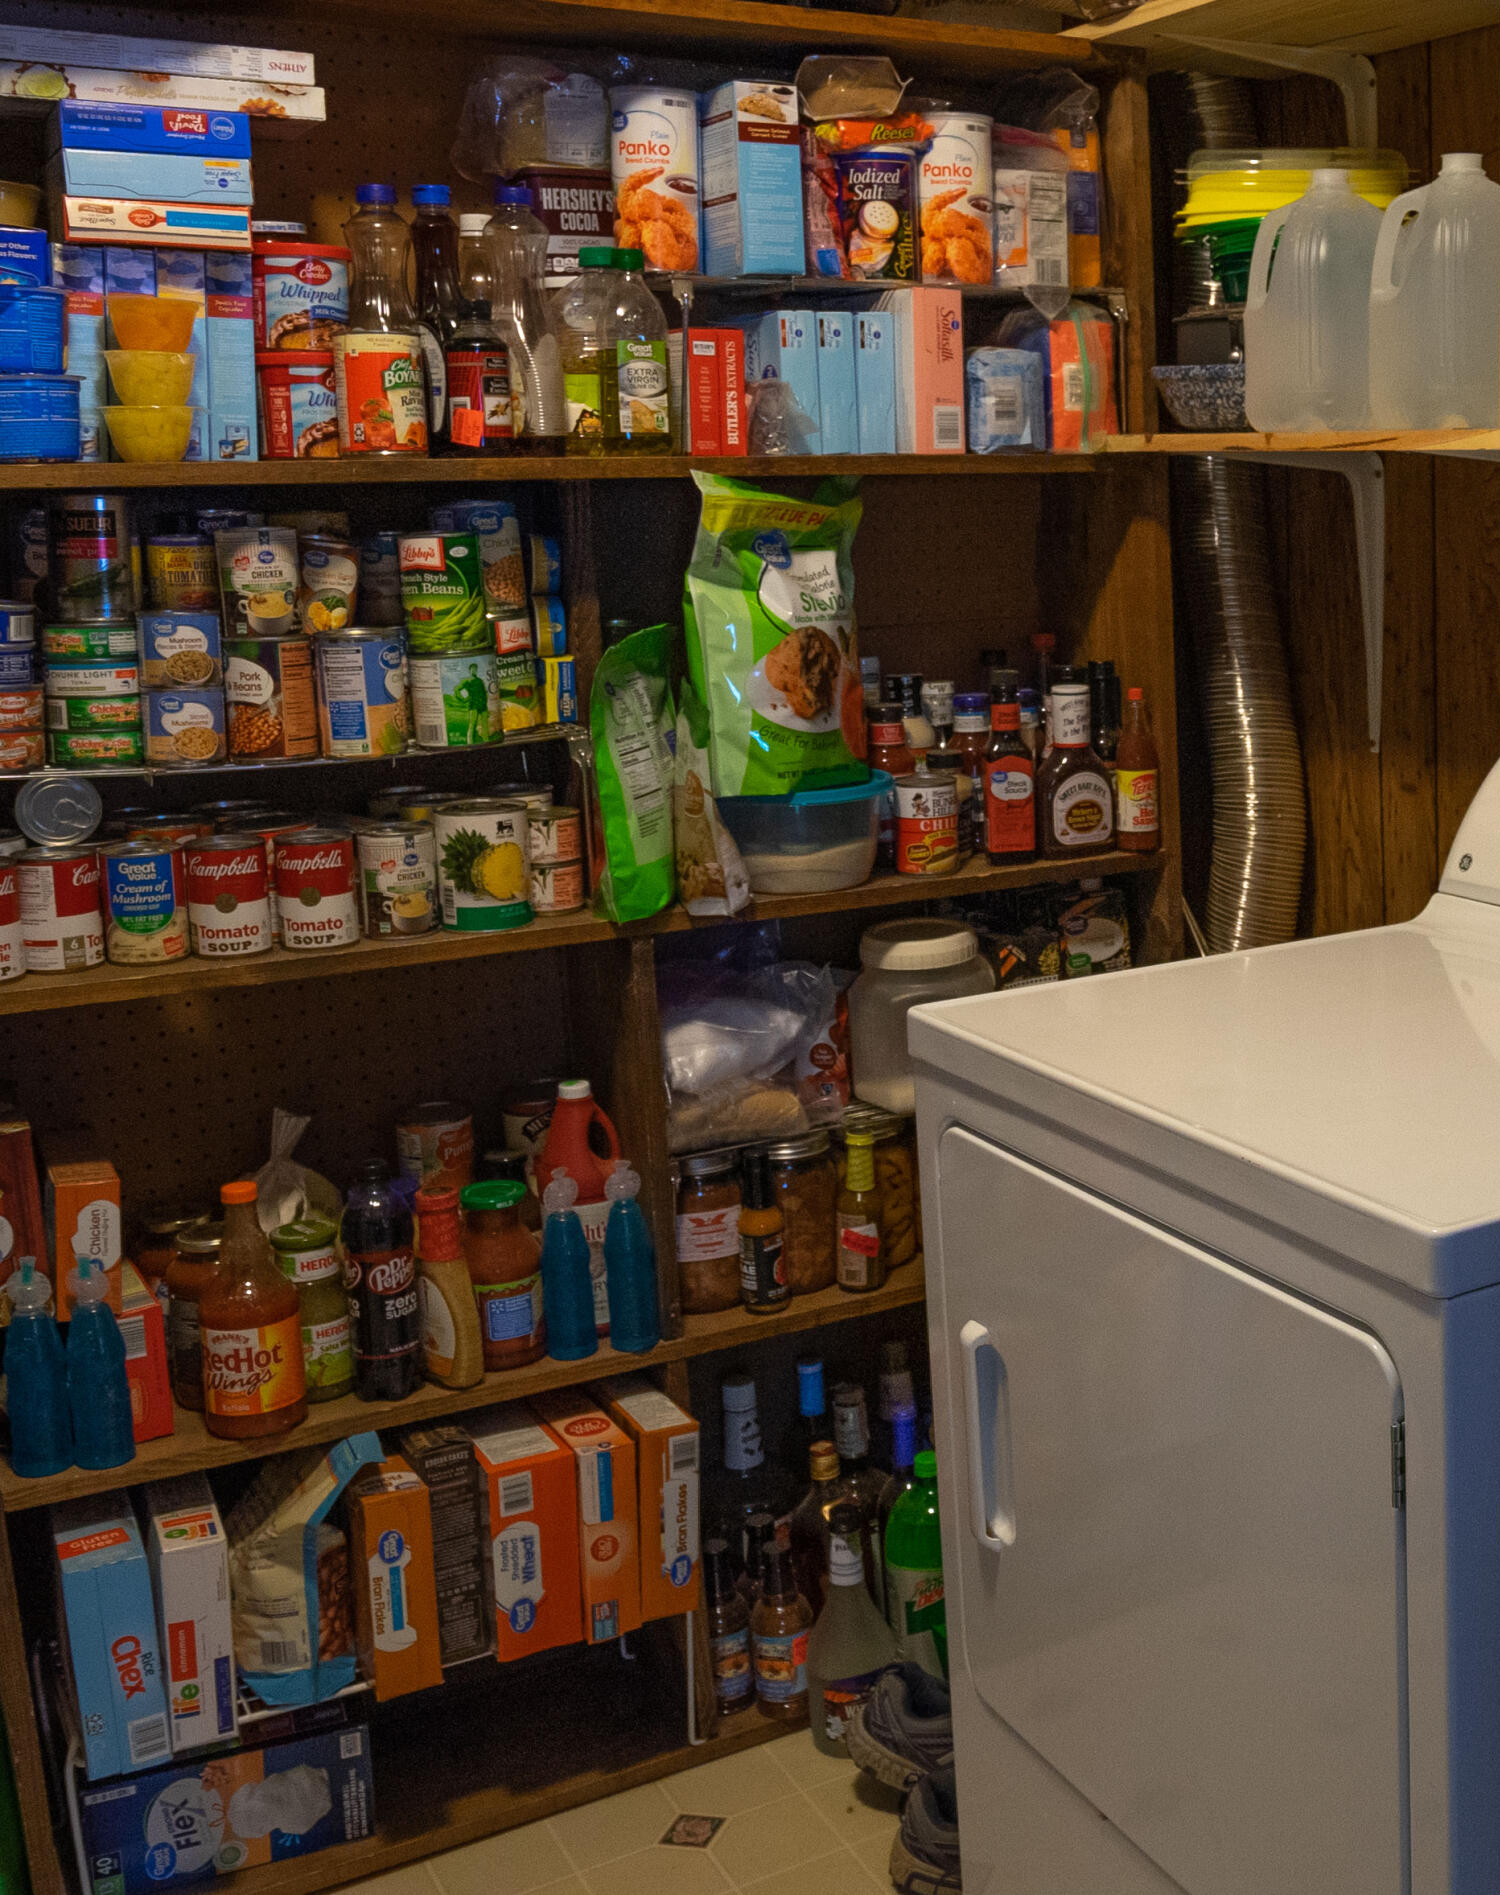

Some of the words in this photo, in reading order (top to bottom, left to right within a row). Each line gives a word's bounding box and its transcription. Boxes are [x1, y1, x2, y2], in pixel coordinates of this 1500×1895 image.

[871, 124, 915, 141] Reese's
[618, 140, 671, 157] Panko
[848, 168, 901, 185] Iodized
[922, 163, 973, 179] Panko
[542, 187, 614, 212] HERSHEY'S
[853, 184, 884, 201] Salt
[559, 212, 600, 231] COCOA
[280, 280, 341, 304] Whipped
[626, 367, 659, 378] EXTRA
[726, 340, 737, 389] EXTRACTS
[626, 376, 660, 386] VIRGIN
[726, 390, 740, 446] BUTLER'S
[401, 546, 436, 562] Libby's
[251, 569, 284, 580] CHICKEN
[422, 573, 449, 583] Style
[422, 582, 465, 596] Beans
[800, 591, 847, 613] Stevia
[495, 654, 525, 667] Cream
[83, 670, 113, 679] LIGHT
[239, 671, 262, 682] Pork
[232, 681, 262, 692] Beans
[117, 861, 156, 875] Great
[187, 854, 261, 881] Campbell's
[275, 849, 346, 874] Campbell's
[127, 872, 158, 882] Value
[396, 871, 426, 882] CHICKEN
[115, 883, 152, 895] Cream
[154, 880, 169, 893] of
[111, 893, 172, 906] Mushroom
[200, 926, 260, 940] Tomato
[285, 917, 344, 932] Tomato
[70, 939, 79, 951] 6
[207, 941, 253, 953] SOUP
[291, 933, 337, 946] SOUP
[495, 1199, 515, 1209] MILD
[89, 1209, 101, 1256] Chicken
[389, 1255, 408, 1272] Dr
[384, 1291, 417, 1312] zero
[385, 1302, 418, 1320] SUGAR
[211, 1333, 250, 1345] FRANK'S
[204, 1341, 284, 1375] RedHot
[207, 1368, 276, 1396] Wings
[677, 1483, 688, 1526] Flakes
[68, 1531, 121, 1549] Gluten
[81, 1538, 114, 1552] Free
[677, 1527, 689, 1554] Bran
[499, 1539, 509, 1573] Frosted
[510, 1537, 520, 1581] Shredded
[520, 1534, 538, 1586] Wheat
[371, 1576, 384, 1602] Bran
[372, 1603, 387, 1636] Flakes
[178, 1629, 189, 1674] cinnamon
[111, 1634, 146, 1700] Chex
[141, 1651, 155, 1677] RICE
[172, 1798, 207, 1851] Flex
[95, 1856, 114, 1875] 40
